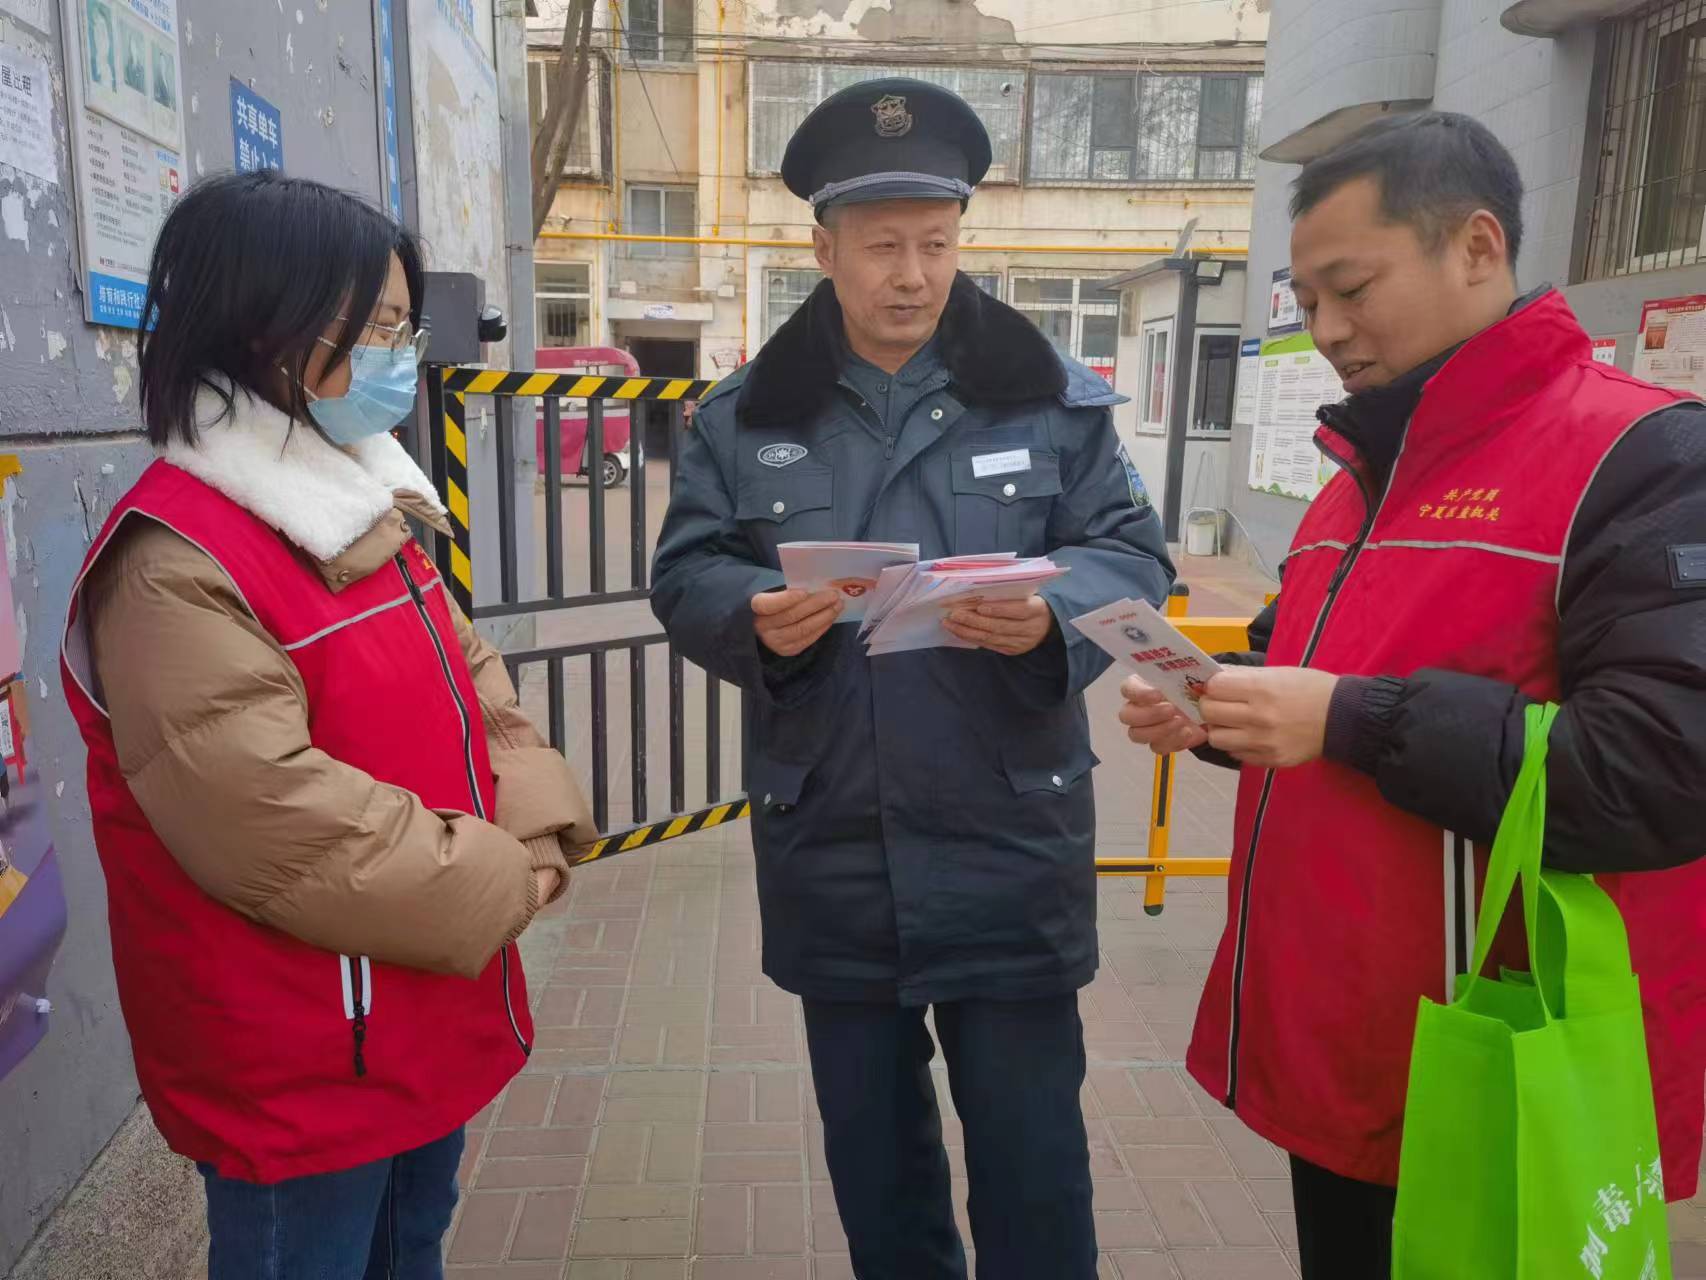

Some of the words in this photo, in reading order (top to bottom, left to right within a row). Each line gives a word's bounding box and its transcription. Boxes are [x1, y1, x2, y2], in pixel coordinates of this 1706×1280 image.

[236, 95, 278, 149] 共享单车
[1443, 488, 1500, 502] 共产党员
